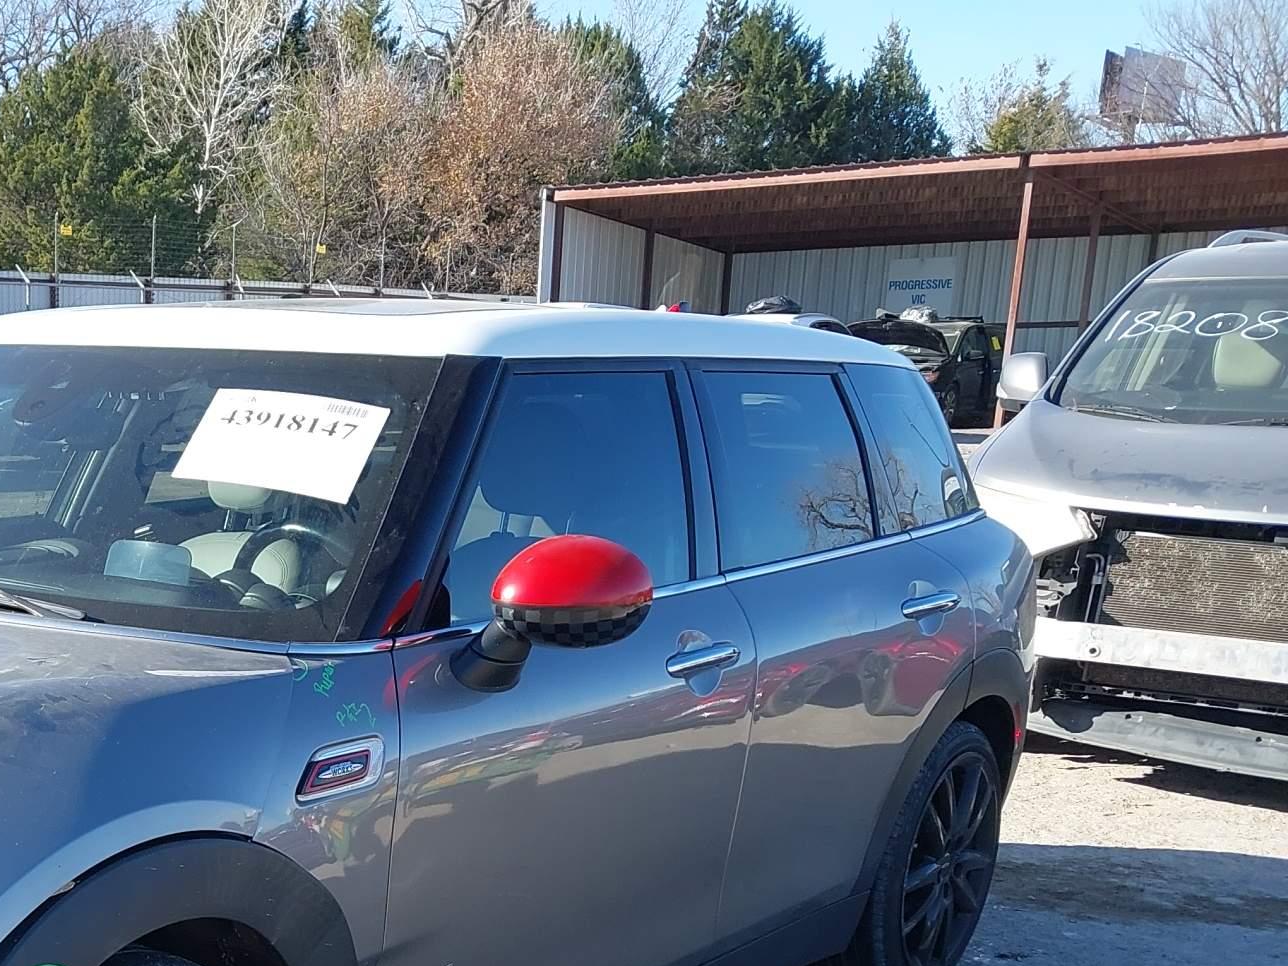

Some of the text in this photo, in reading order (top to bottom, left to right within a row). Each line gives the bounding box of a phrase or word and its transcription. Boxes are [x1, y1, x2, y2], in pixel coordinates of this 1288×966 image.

[889, 278, 953, 291] PROGRESSIVE
[1104, 310, 1288, 342] 18208
[220, 409, 358, 439] 43918147
